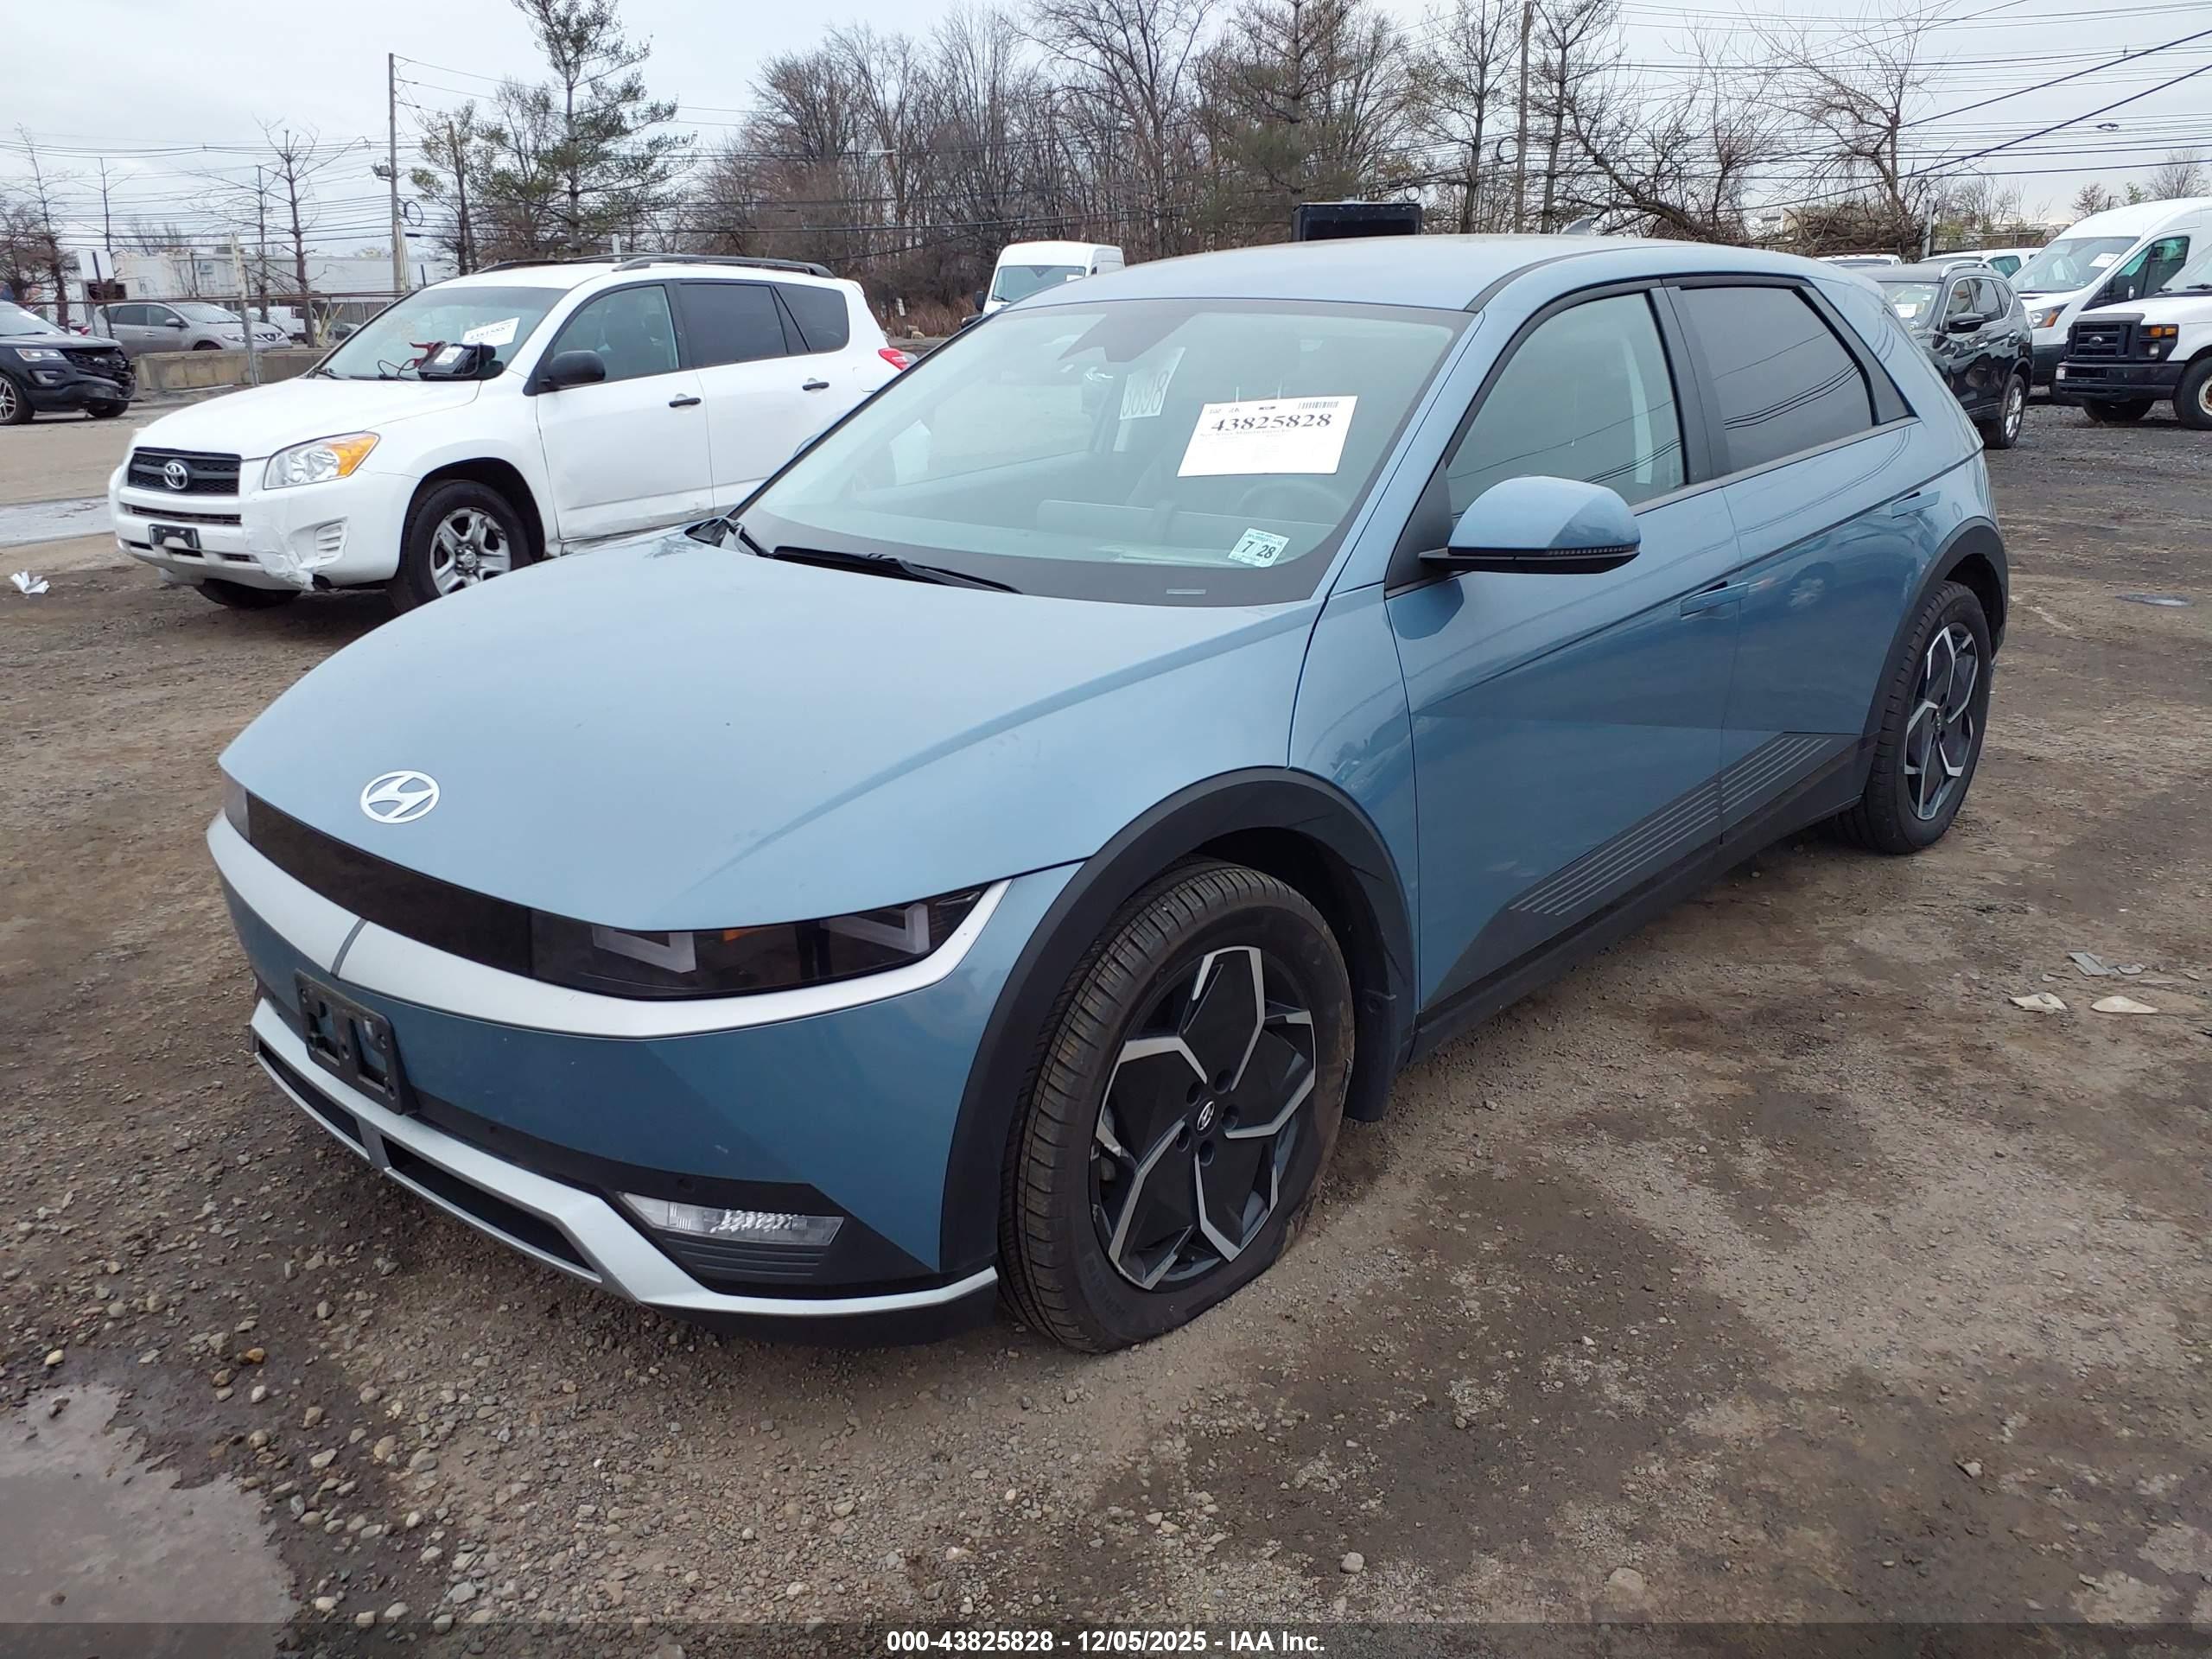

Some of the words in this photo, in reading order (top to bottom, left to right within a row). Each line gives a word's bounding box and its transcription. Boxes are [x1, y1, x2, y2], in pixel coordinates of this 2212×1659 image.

[1211, 413, 1332, 431] 43825828
[1242, 540, 1255, 553] 7
[1256, 544, 1276, 559] 28
